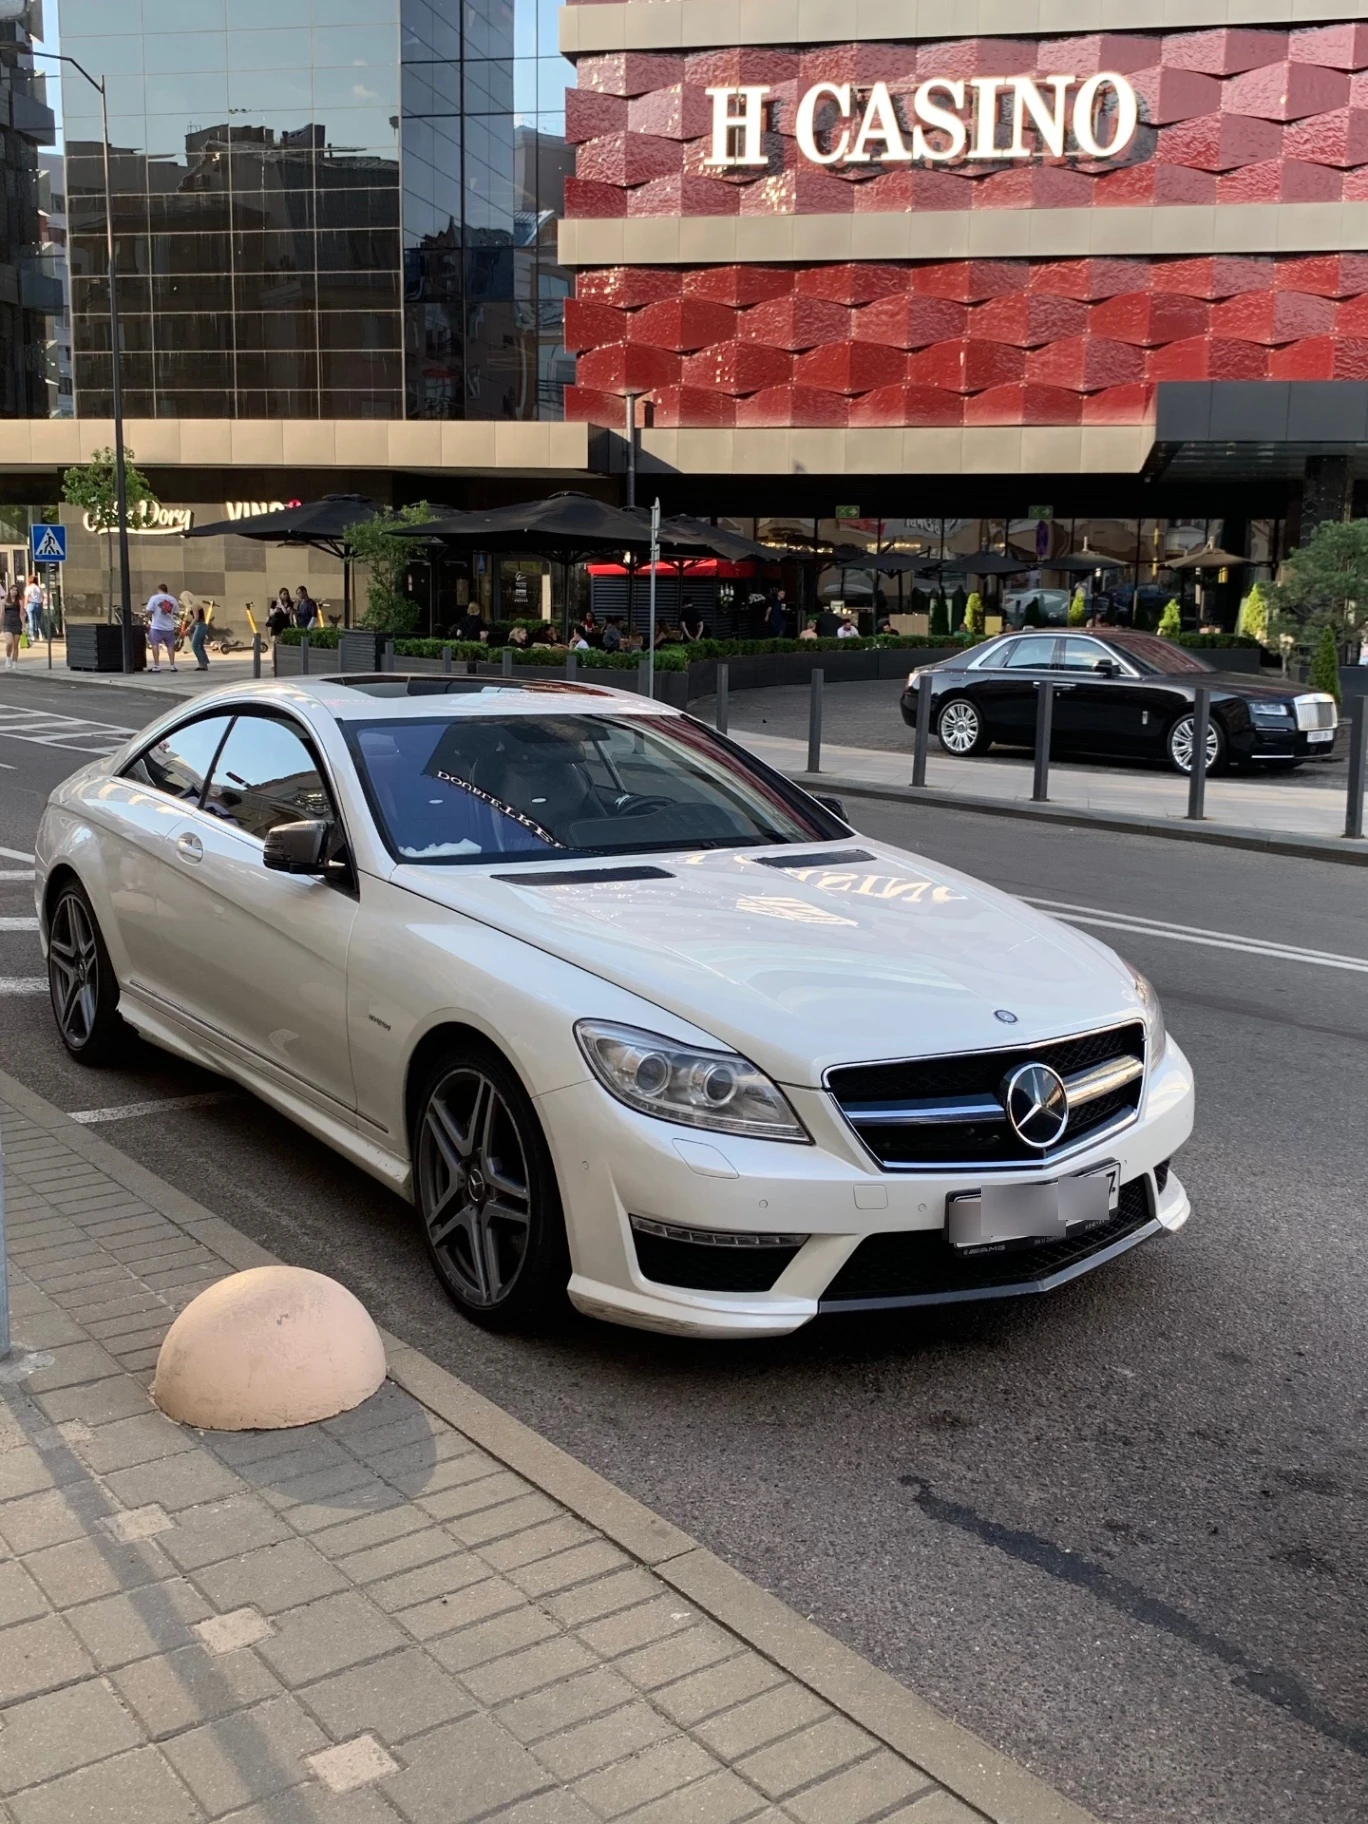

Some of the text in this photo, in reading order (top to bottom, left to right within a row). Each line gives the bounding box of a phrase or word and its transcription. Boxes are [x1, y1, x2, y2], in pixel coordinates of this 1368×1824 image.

[703, 72, 1138, 166] H CASINO
[140, 500, 191, 531] Dory
